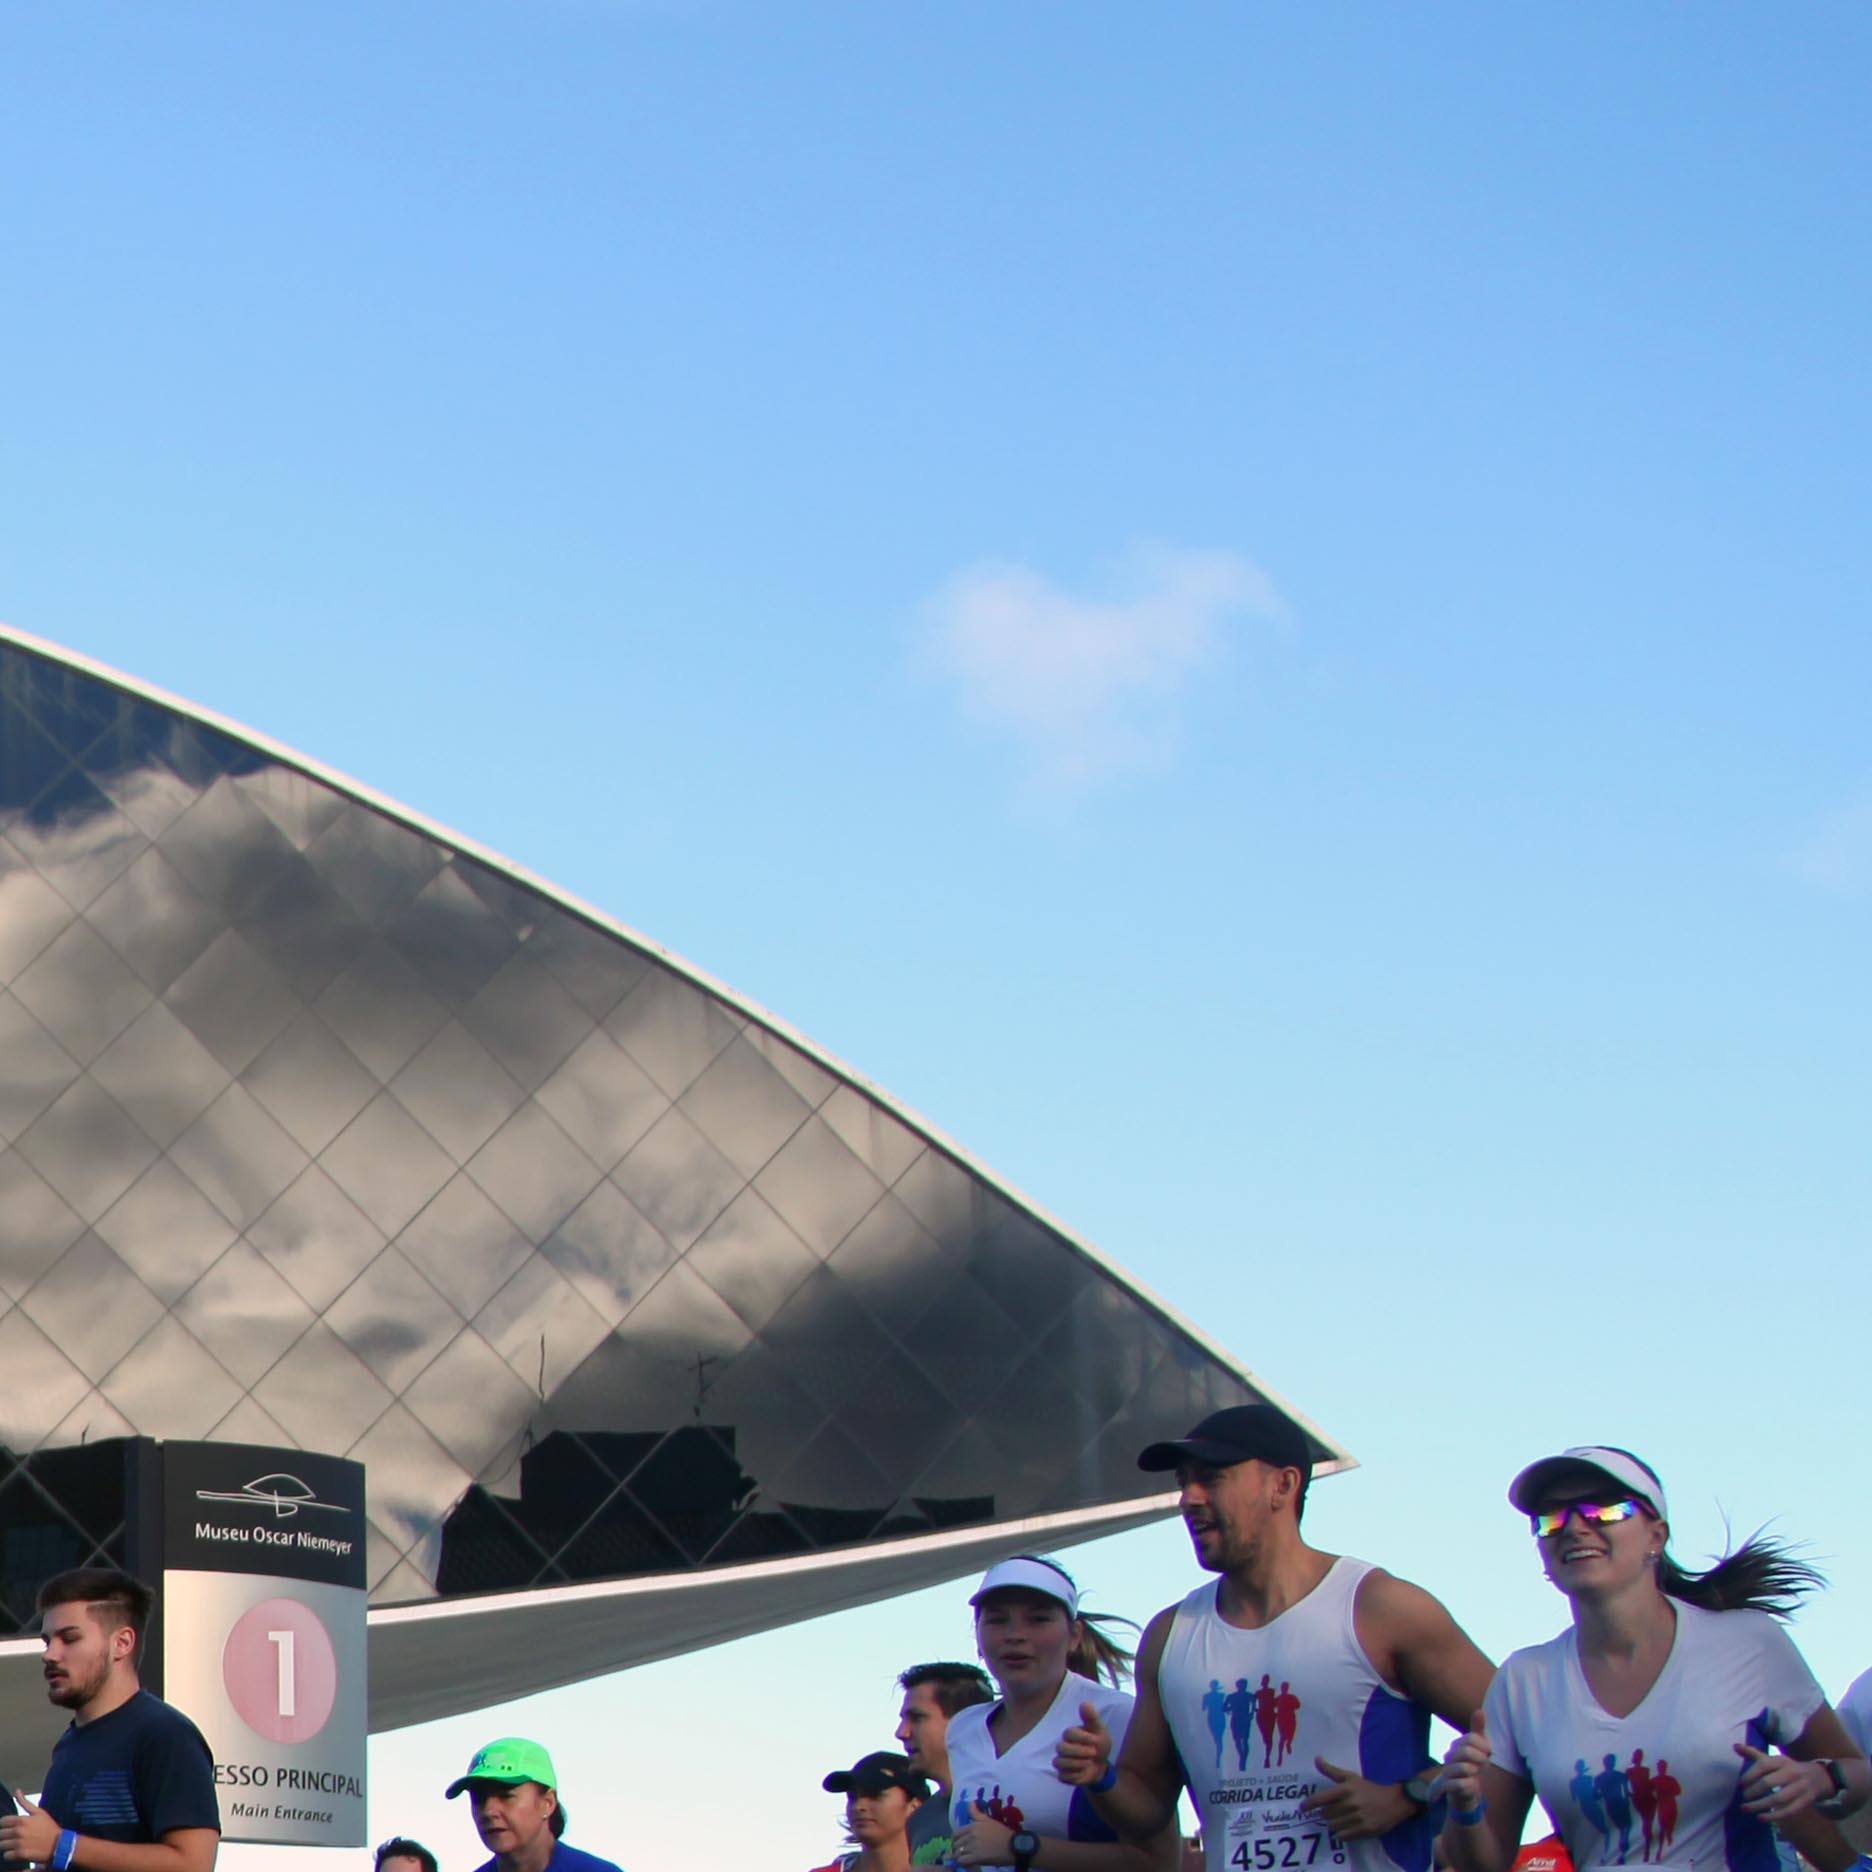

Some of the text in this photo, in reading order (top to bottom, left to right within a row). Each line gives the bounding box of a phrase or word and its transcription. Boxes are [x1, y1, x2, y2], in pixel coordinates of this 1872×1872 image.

[195, 1523, 353, 1556] Museu Oscar Niemeyer
[268, 1630, 295, 1716] 1
[213, 1764, 363, 1798] ESSO PRINCIPAL
[231, 1803, 334, 1823] Main Entrance
[1231, 1832, 1323, 1872] 4527
